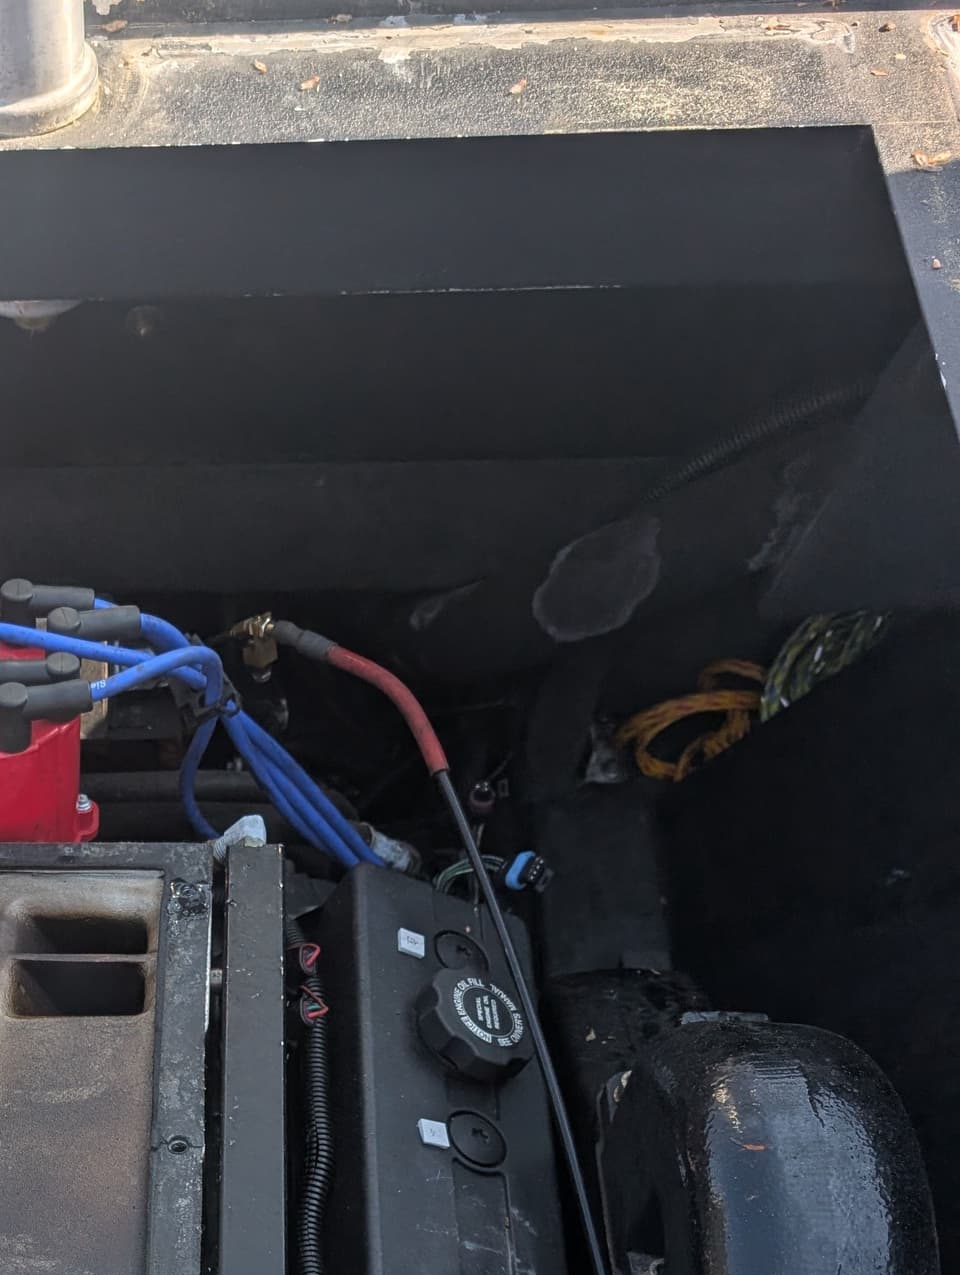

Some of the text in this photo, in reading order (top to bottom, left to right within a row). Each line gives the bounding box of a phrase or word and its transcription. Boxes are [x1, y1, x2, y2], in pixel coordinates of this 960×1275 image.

[457, 980, 470, 990] OIL
[466, 978, 484, 987] FILL
[453, 986, 466, 1016] ENGINE
[490, 983, 517, 1011] MANUAL
